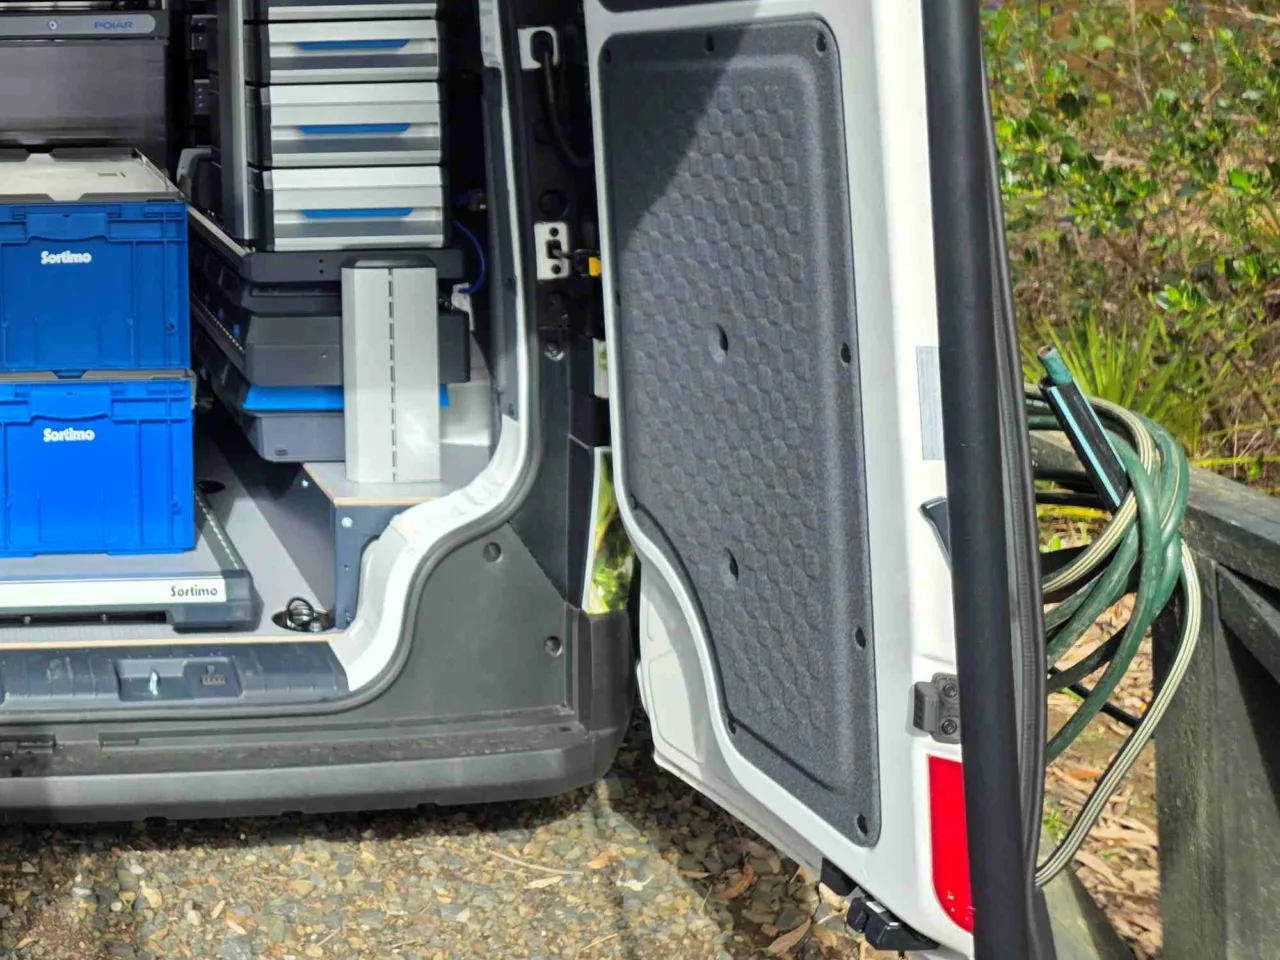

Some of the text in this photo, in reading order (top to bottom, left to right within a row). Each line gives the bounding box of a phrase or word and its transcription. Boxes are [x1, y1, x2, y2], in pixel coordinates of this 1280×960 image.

[40, 250, 93, 265] Sortimo
[43, 427, 96, 442] Sortimo
[170, 584, 218, 597] Sortimo
